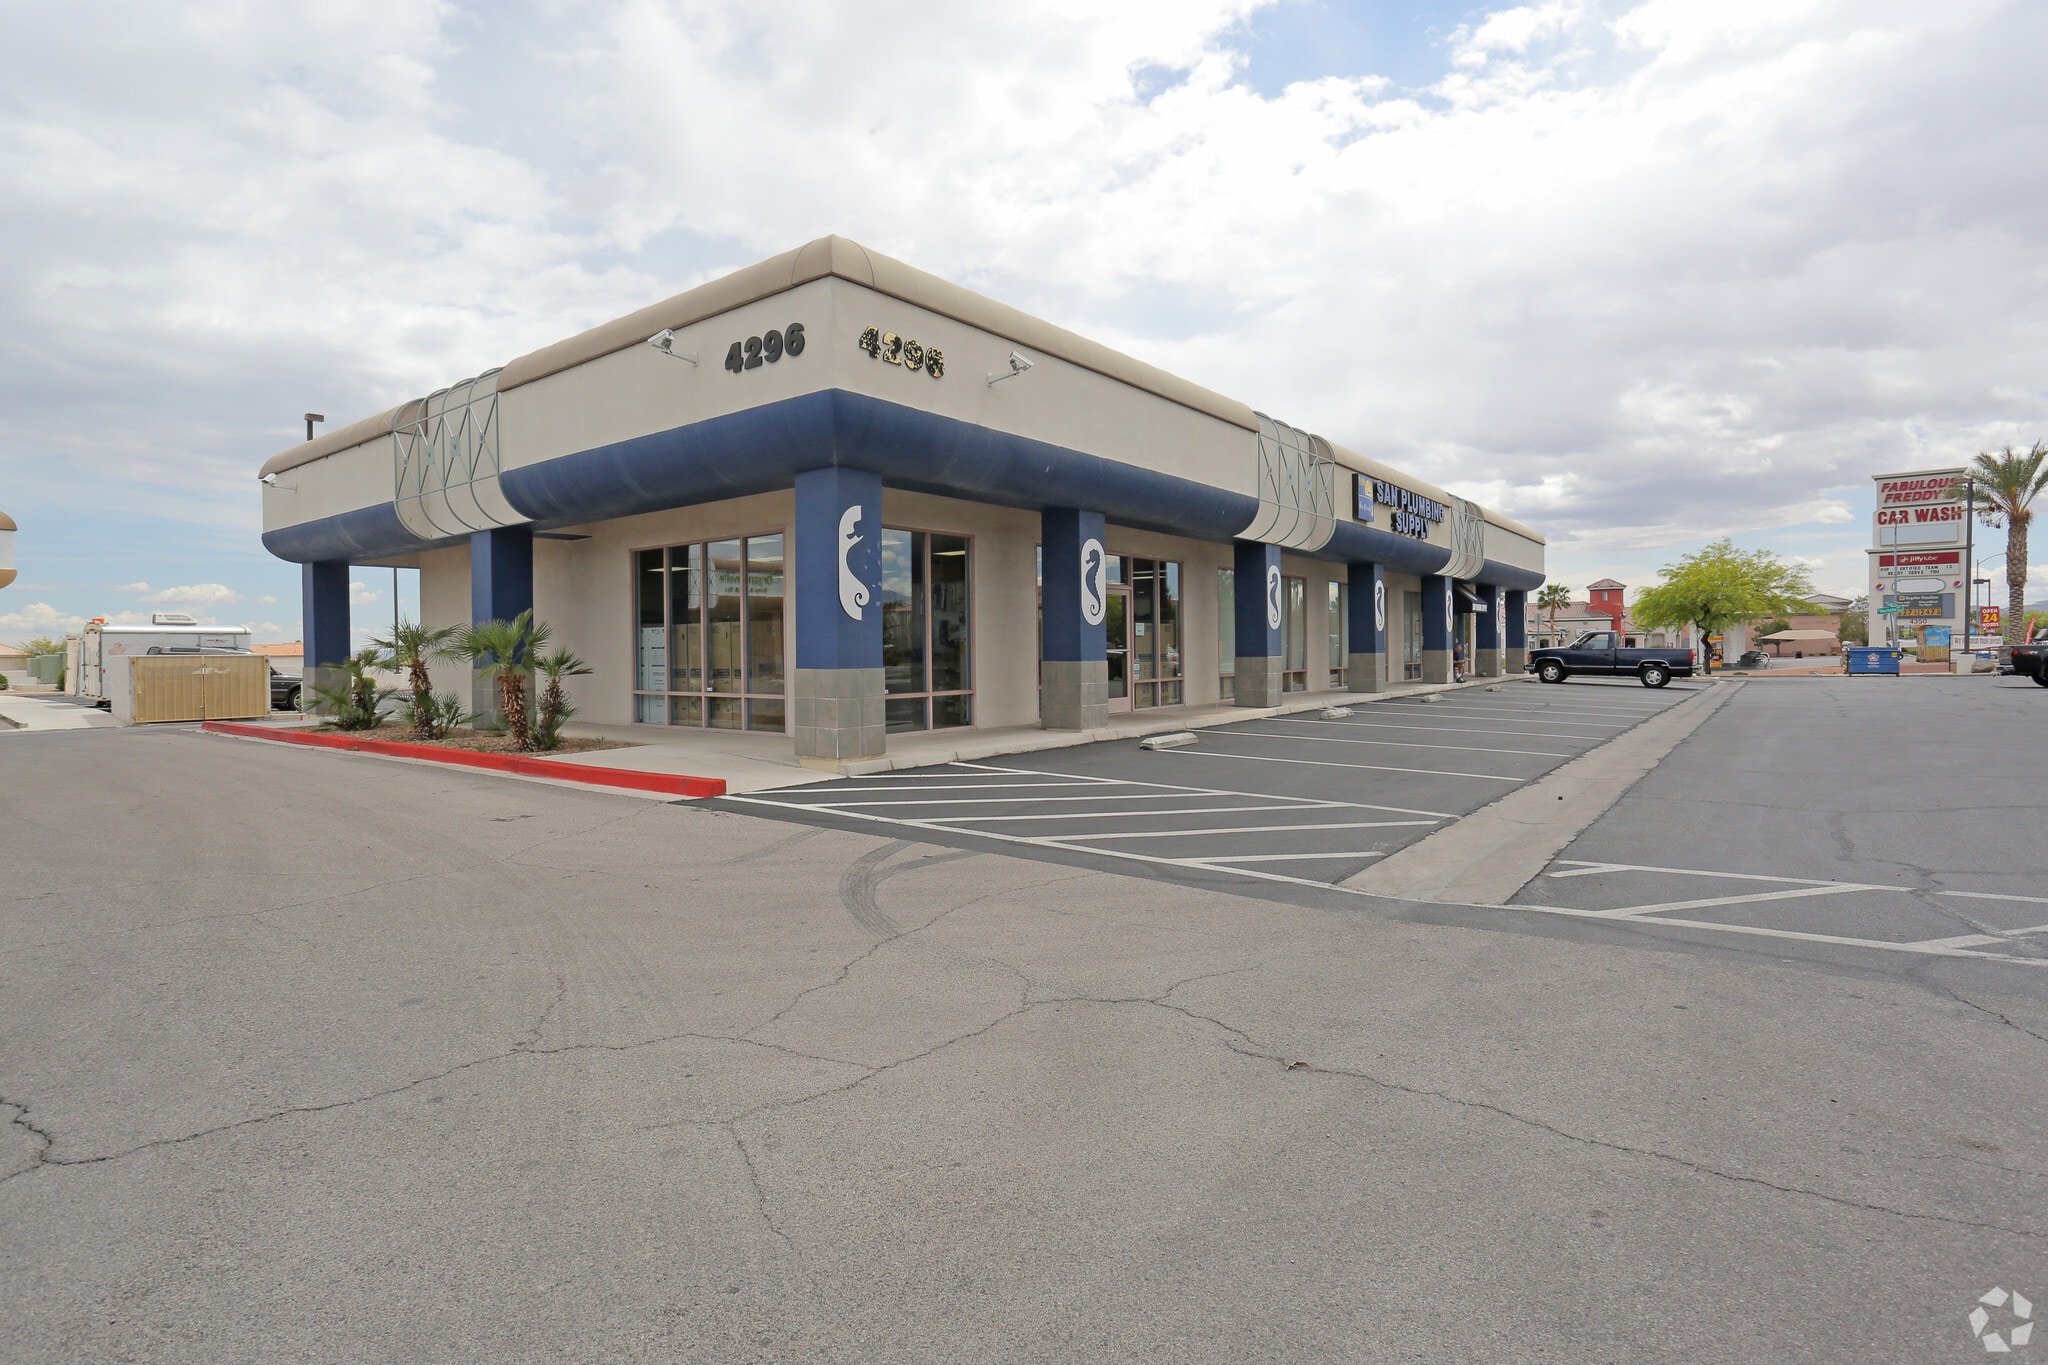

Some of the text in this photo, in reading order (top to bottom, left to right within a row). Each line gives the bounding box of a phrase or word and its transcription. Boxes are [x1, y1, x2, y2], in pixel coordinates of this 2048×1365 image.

[724, 322, 805, 374] 4296
[858, 326, 945, 379] 4296
[1881, 478, 1957, 493] FABULOUS
[1401, 489, 1445, 523] PLUMBING
[1877, 505, 1962, 525] CAR WASH
[1395, 510, 1430, 539] SUPPLY
[1982, 613, 1999, 623] 24
